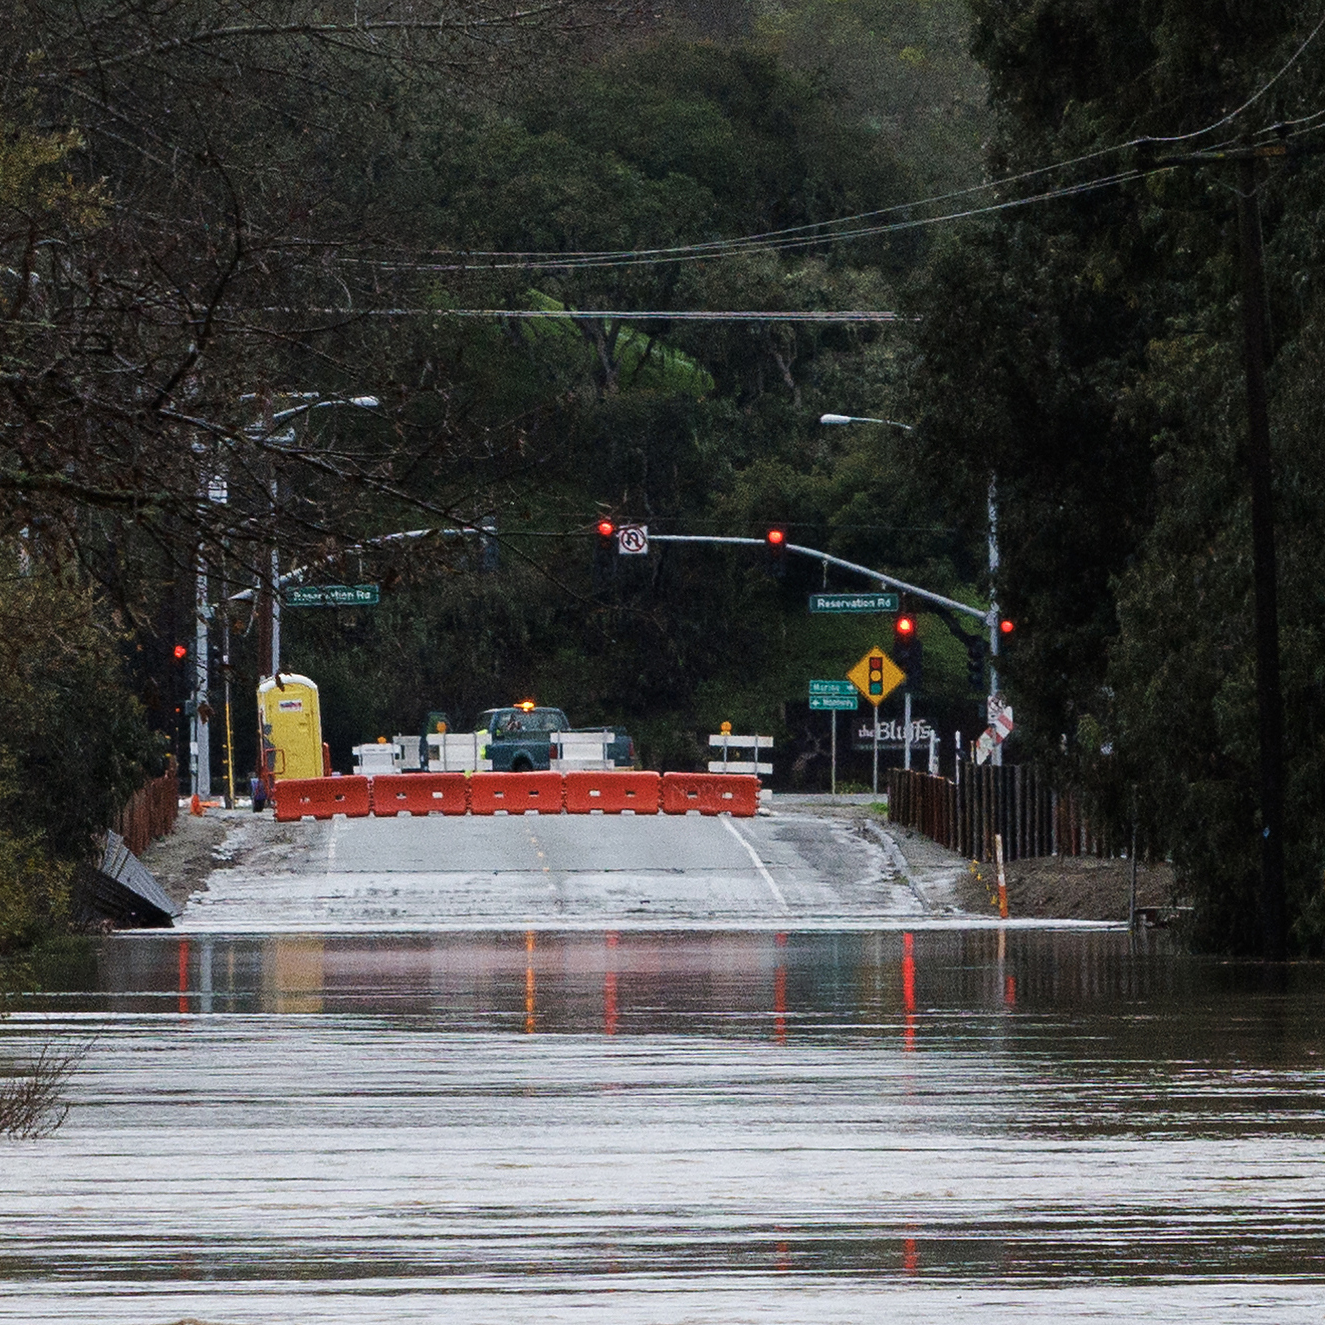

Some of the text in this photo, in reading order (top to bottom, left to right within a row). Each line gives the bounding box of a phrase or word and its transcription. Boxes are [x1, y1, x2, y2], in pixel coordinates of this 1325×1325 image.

[356, 590, 370, 599] Rd
[817, 598, 891, 608] Reservation Rd
